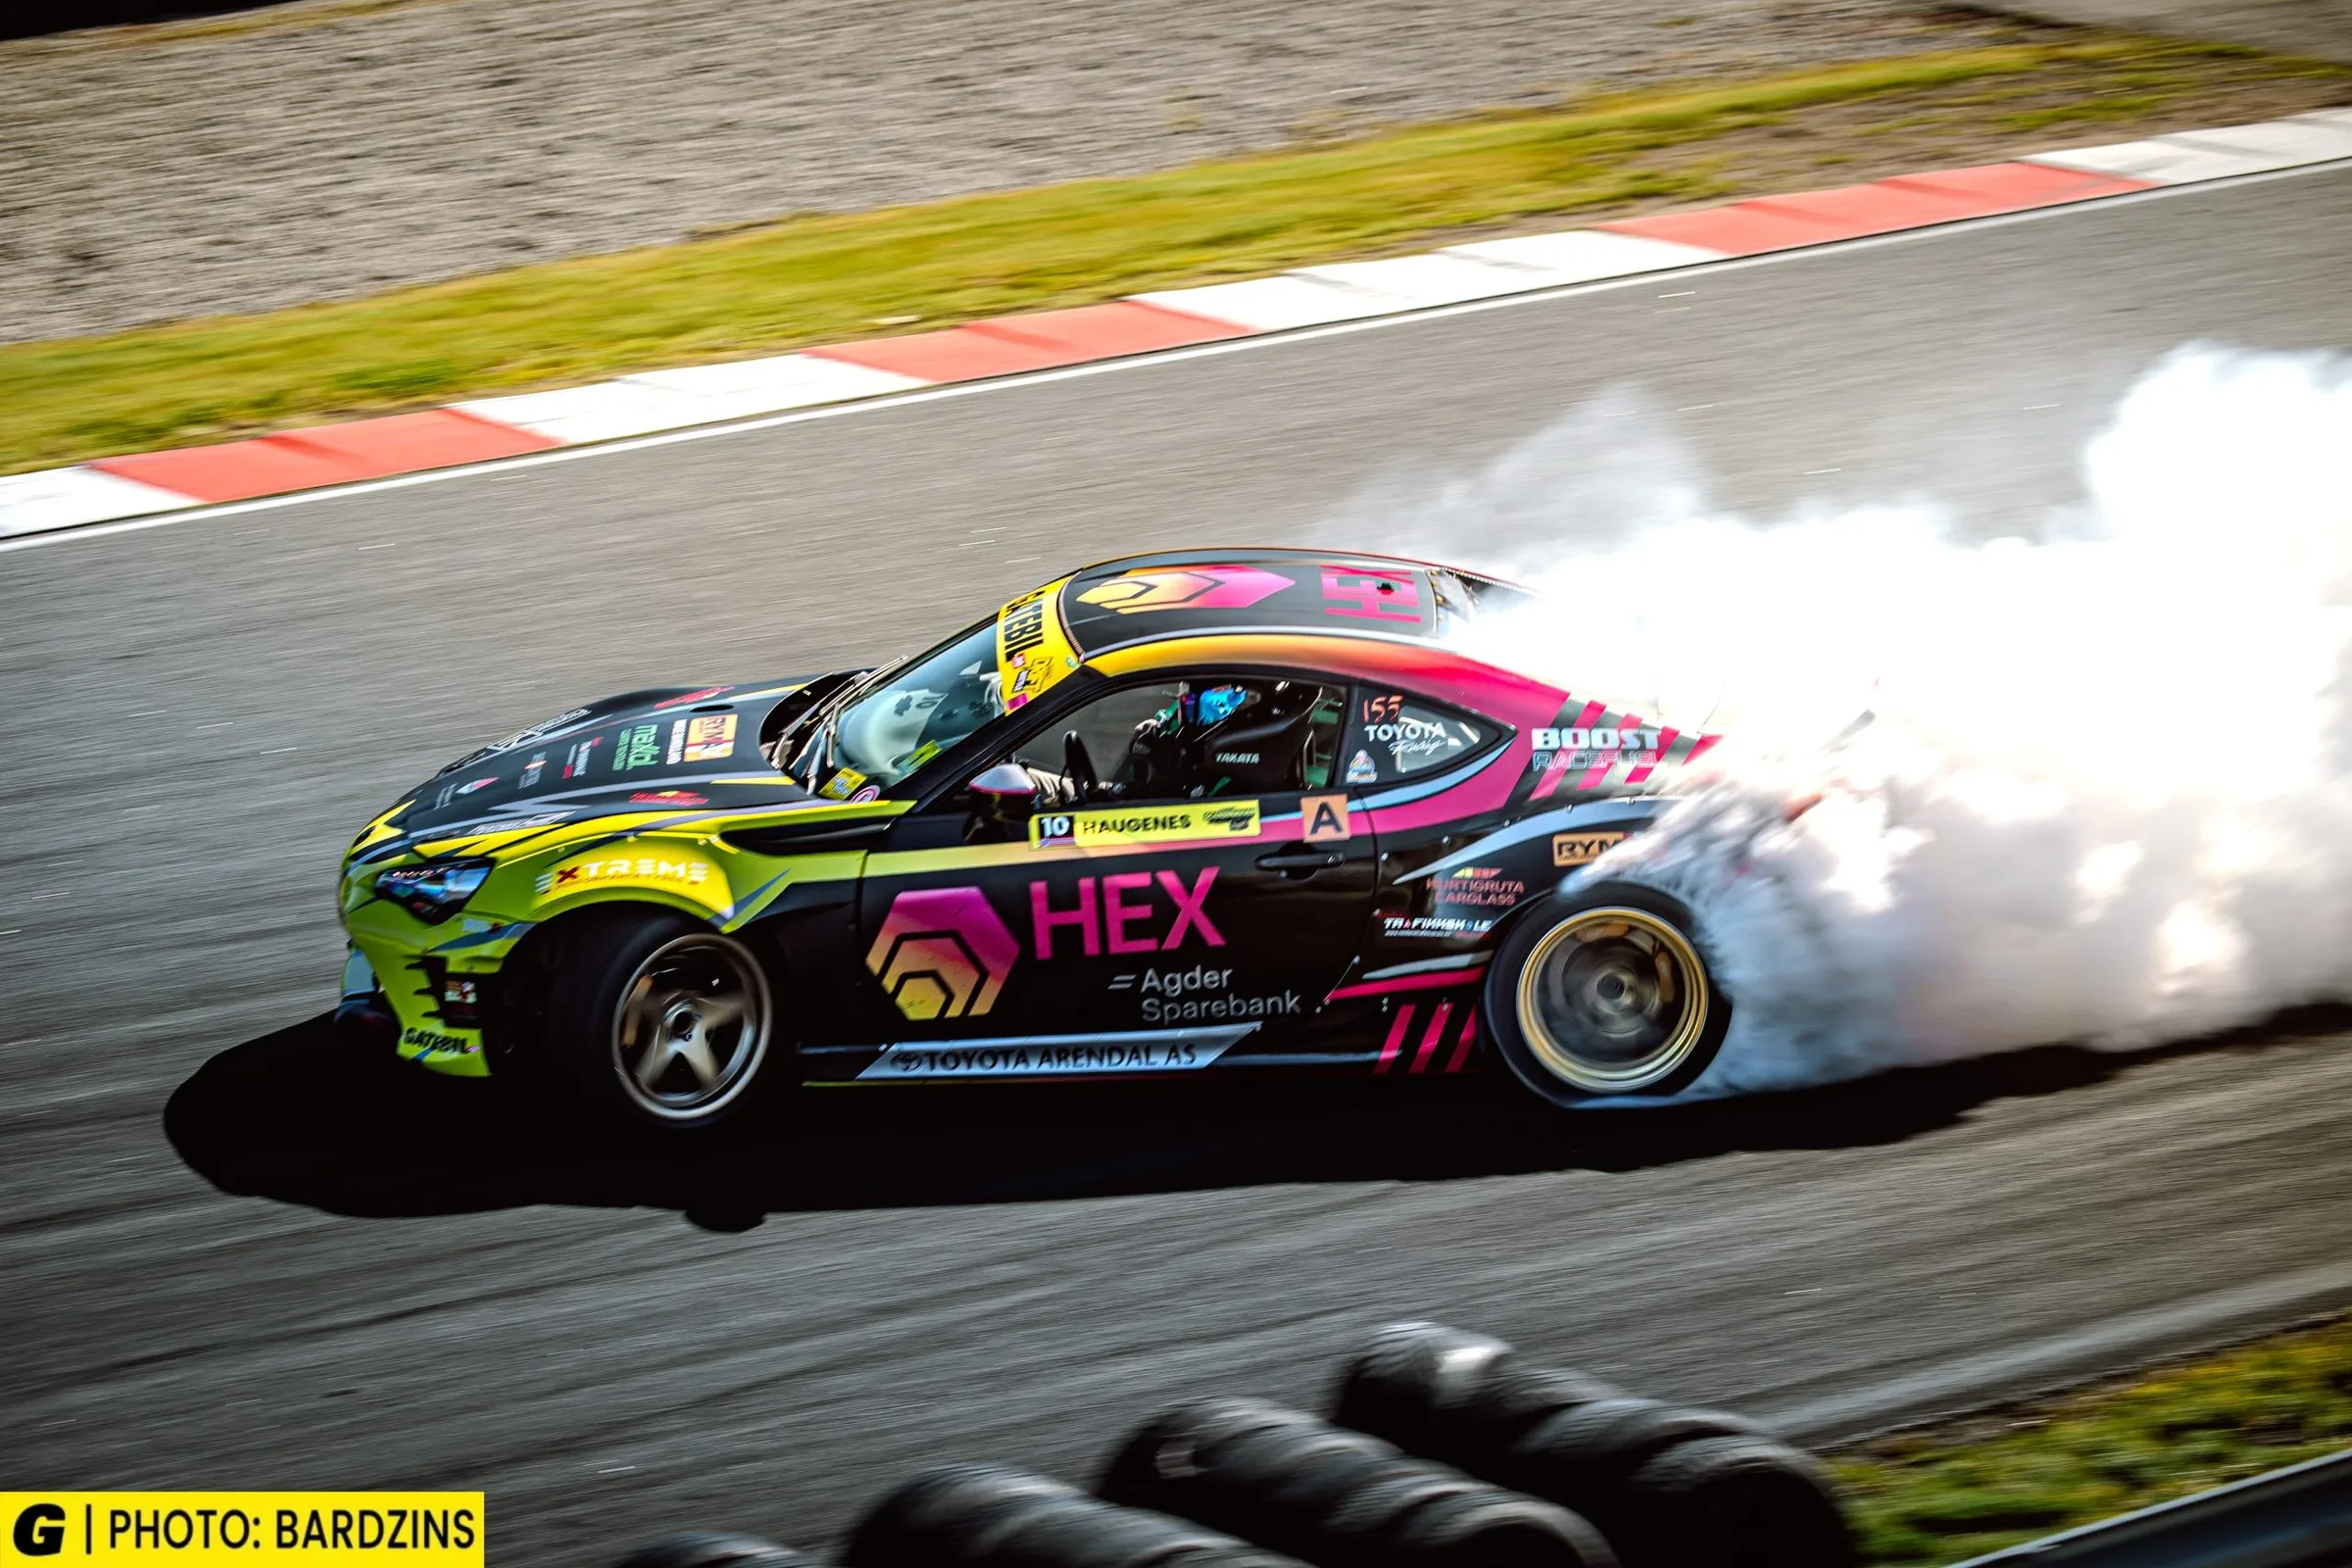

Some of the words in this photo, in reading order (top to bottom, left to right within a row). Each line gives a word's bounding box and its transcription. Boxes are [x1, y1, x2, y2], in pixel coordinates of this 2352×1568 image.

[1363, 695, 1403, 724] 155
[1364, 721, 1446, 742] TOYOTA
[1531, 727, 1660, 751] BOOST
[1215, 752, 1261, 764] TAKATA
[1040, 815, 1069, 836] 10
[1083, 813, 1192, 836] HAUGENES
[1309, 802, 1344, 835] A
[1030, 866, 1226, 960] HEX
[1140, 964, 1233, 998] Agder
[1141, 989, 1301, 1026] Sparebank
[930, 1048, 1031, 1072] TOYOTA
[1037, 1044, 1156, 1070] ARENDAL
[1163, 1042, 1198, 1066] AS
